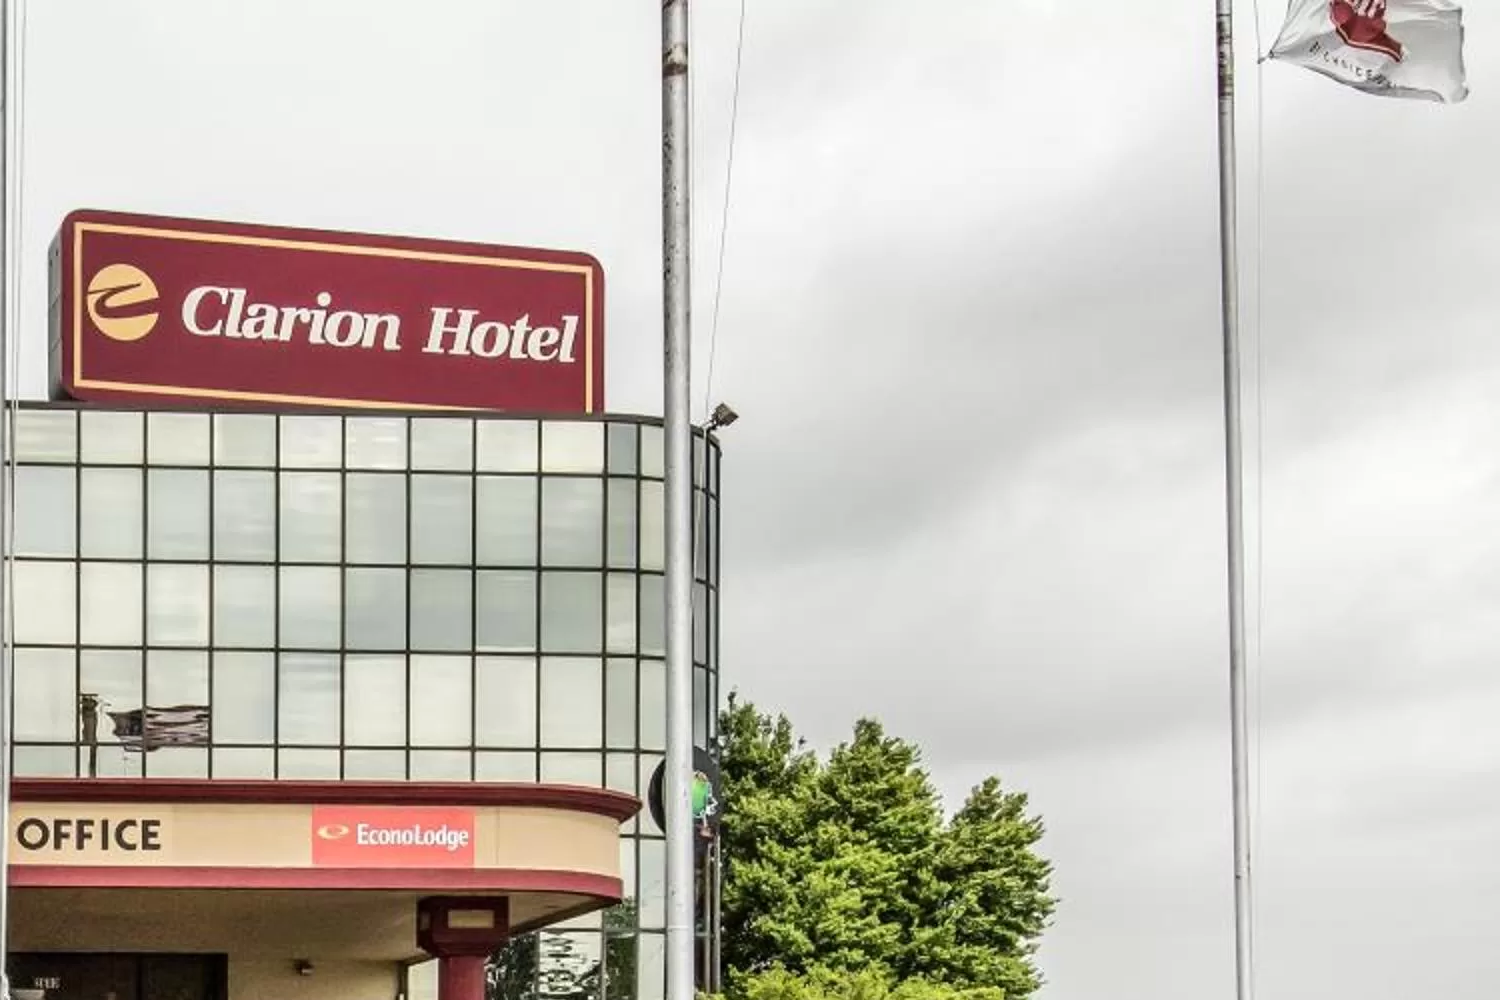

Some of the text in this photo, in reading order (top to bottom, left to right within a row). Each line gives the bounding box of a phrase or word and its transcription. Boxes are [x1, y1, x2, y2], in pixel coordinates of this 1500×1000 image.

[181, 285, 580, 363] Clarion Hotel
[16, 818, 162, 851] OFFICE
[356, 823, 469, 850] EconoLodge
